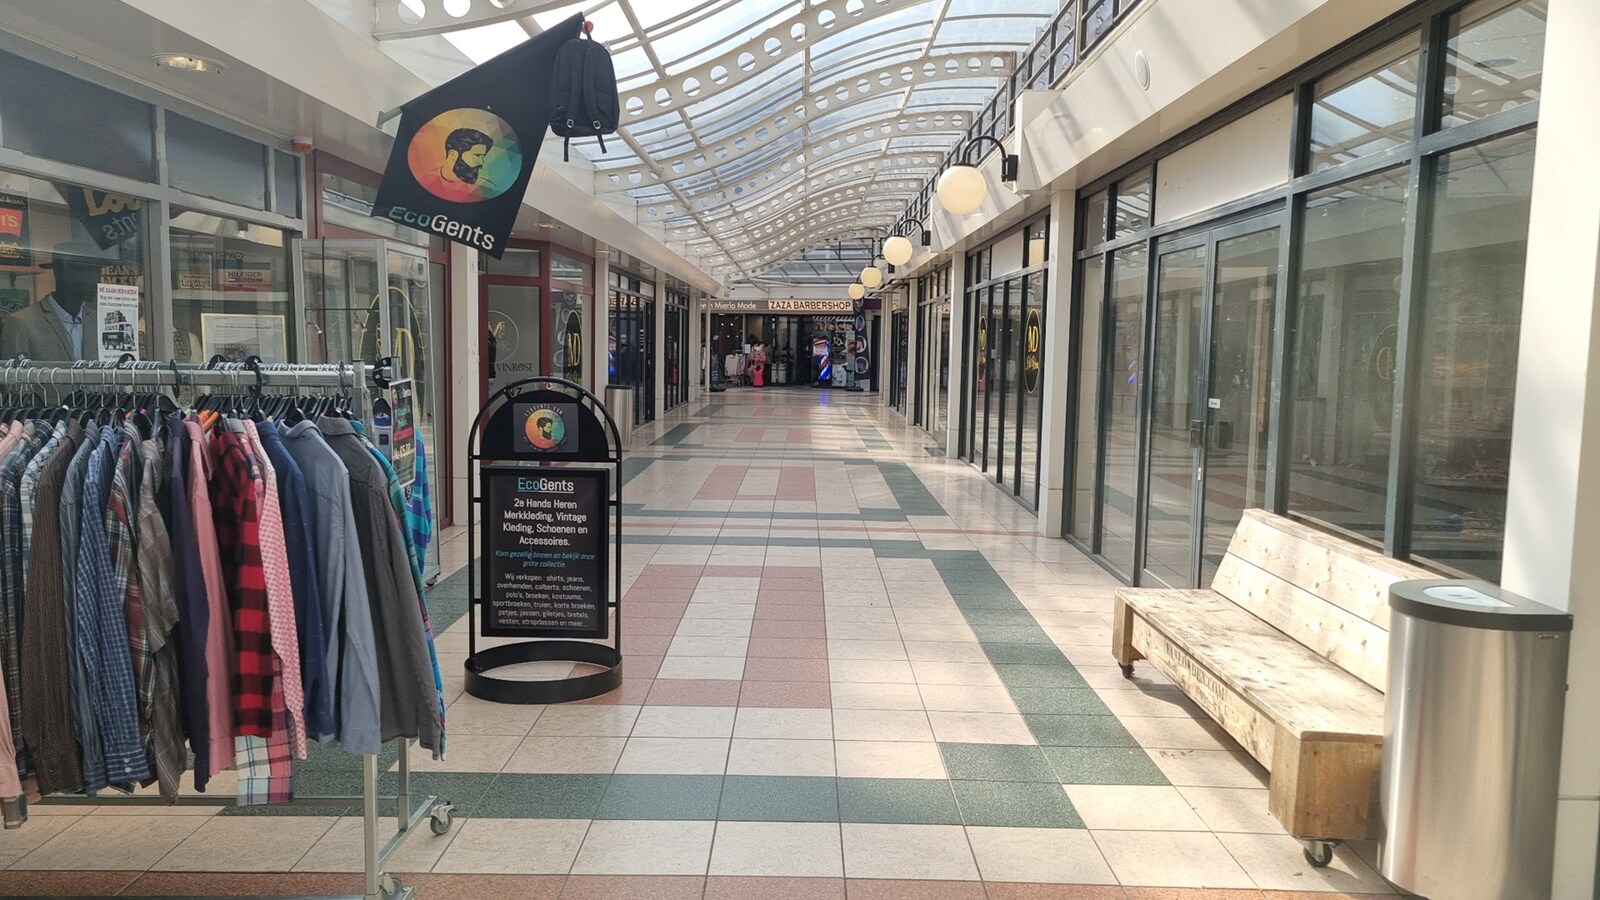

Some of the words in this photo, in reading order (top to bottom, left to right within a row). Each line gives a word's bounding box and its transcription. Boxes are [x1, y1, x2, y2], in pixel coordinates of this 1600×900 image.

[388, 206, 496, 250] EcoGents
[228, 271, 263, 279] HILFIGER
[737, 300, 757, 310] Mode
[769, 301, 792, 309] ZAZA
[793, 301, 851, 310] BARBERSHOP
[518, 477, 575, 492] EcoGents
[513, 497, 524, 508] 2e
[526, 498, 552, 509] Hands
[553, 499, 578, 509] Heren
[504, 510, 554, 523] Merkkleding,
[555, 511, 587, 524] Vintage
[502, 522, 535, 535] Kleding,
[536, 523, 576, 534] Schoenen
[577, 526, 588, 534] en
[519, 535, 571, 546] Accessoires.
[509, 550, 533, 559] gezellig
[532, 551, 553, 559] binnen
[561, 552, 579, 560] bekijk
[522, 560, 539, 568] grote
[539, 560, 566, 568] collectie.
[504, 573, 515, 581] Wij
[515, 573, 542, 582] verkopen
[546, 575, 566, 583] shirts,
[496, 582, 534, 591] overhemden,
[534, 583, 561, 591] colberts,
[562, 584, 593, 592] schoenen,
[525, 592, 551, 600] broeken,
[551, 593, 583, 601] kostuums,
[492, 600, 533, 608] sportbroeken,
[533, 601, 553, 609] truien,
[570, 602, 597, 610] broeken,
[498, 609, 519, 617] petjes,
[542, 610, 566, 618] giletjes,
[566, 611, 590, 619] bretels,
[521, 618, 559, 626] stropdassen
